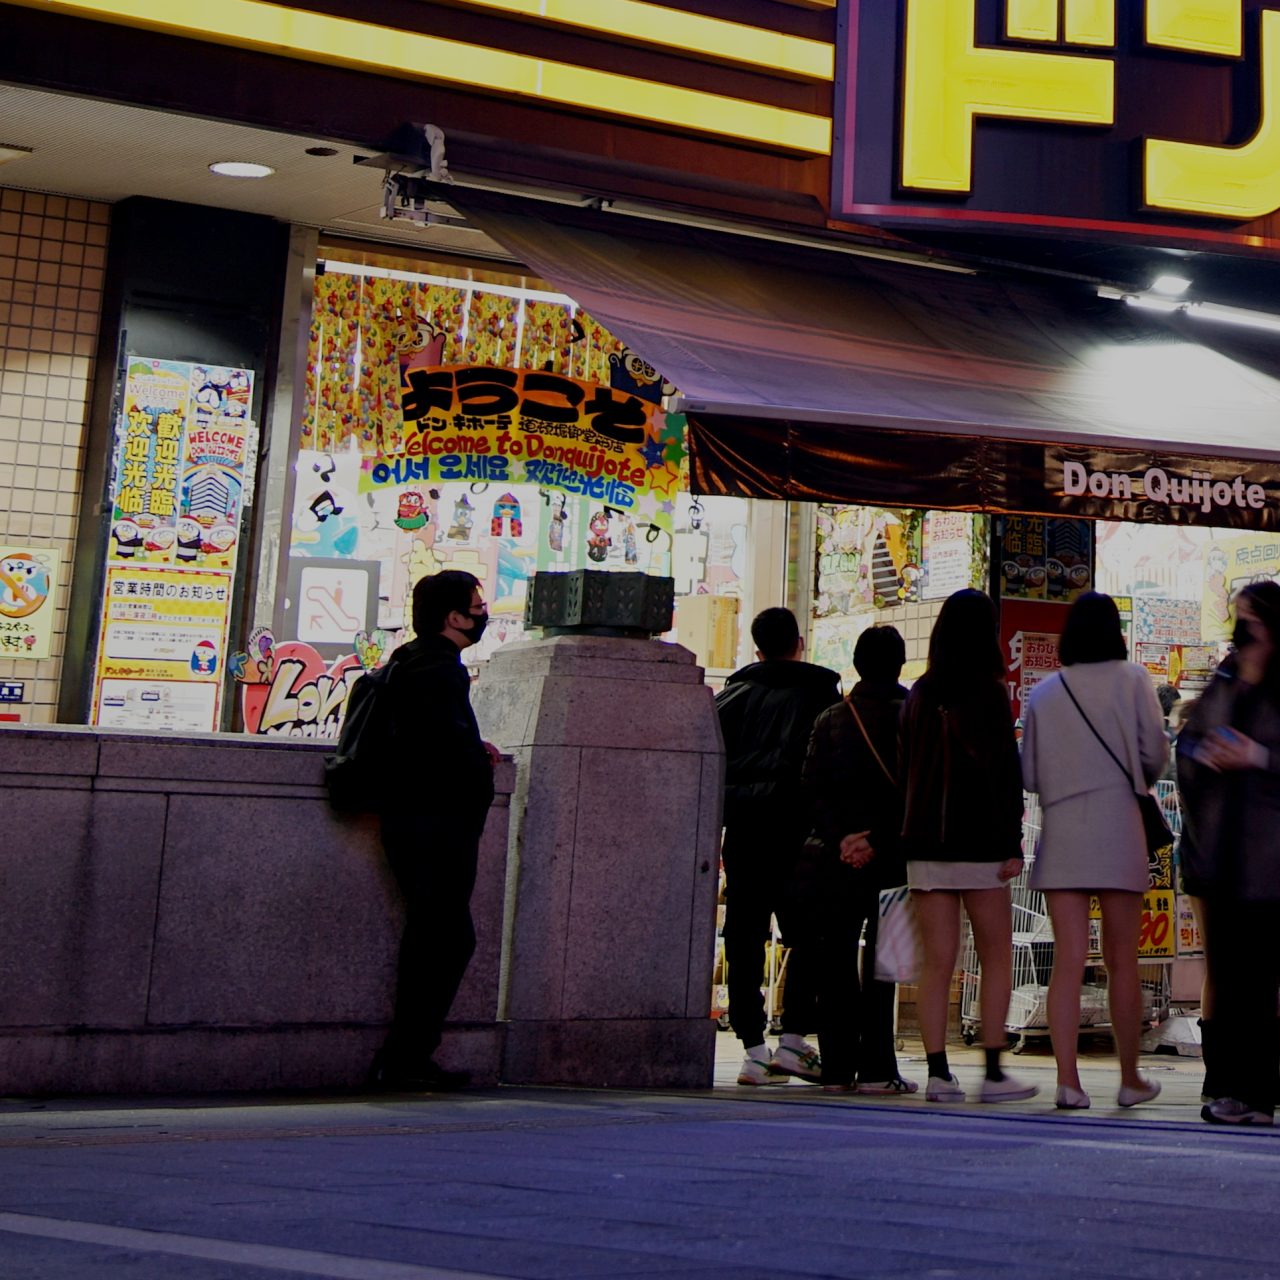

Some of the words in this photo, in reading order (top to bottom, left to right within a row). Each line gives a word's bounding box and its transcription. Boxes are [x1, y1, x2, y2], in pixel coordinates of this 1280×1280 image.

[402, 367, 647, 444] ようこそ
[188, 431, 245, 449] WELCOME
[496, 431, 523, 456] to
[120, 411, 152, 513] 欢迎光临
[149, 413, 182, 516] 歡迎光臨
[372, 456, 430, 484] 어서
[438, 454, 509, 481] 오세요
[1063, 461, 1132, 499] Don
[1143, 468, 1266, 513] Quijote
[113, 581, 225, 600] 営業時間のお知らせ
